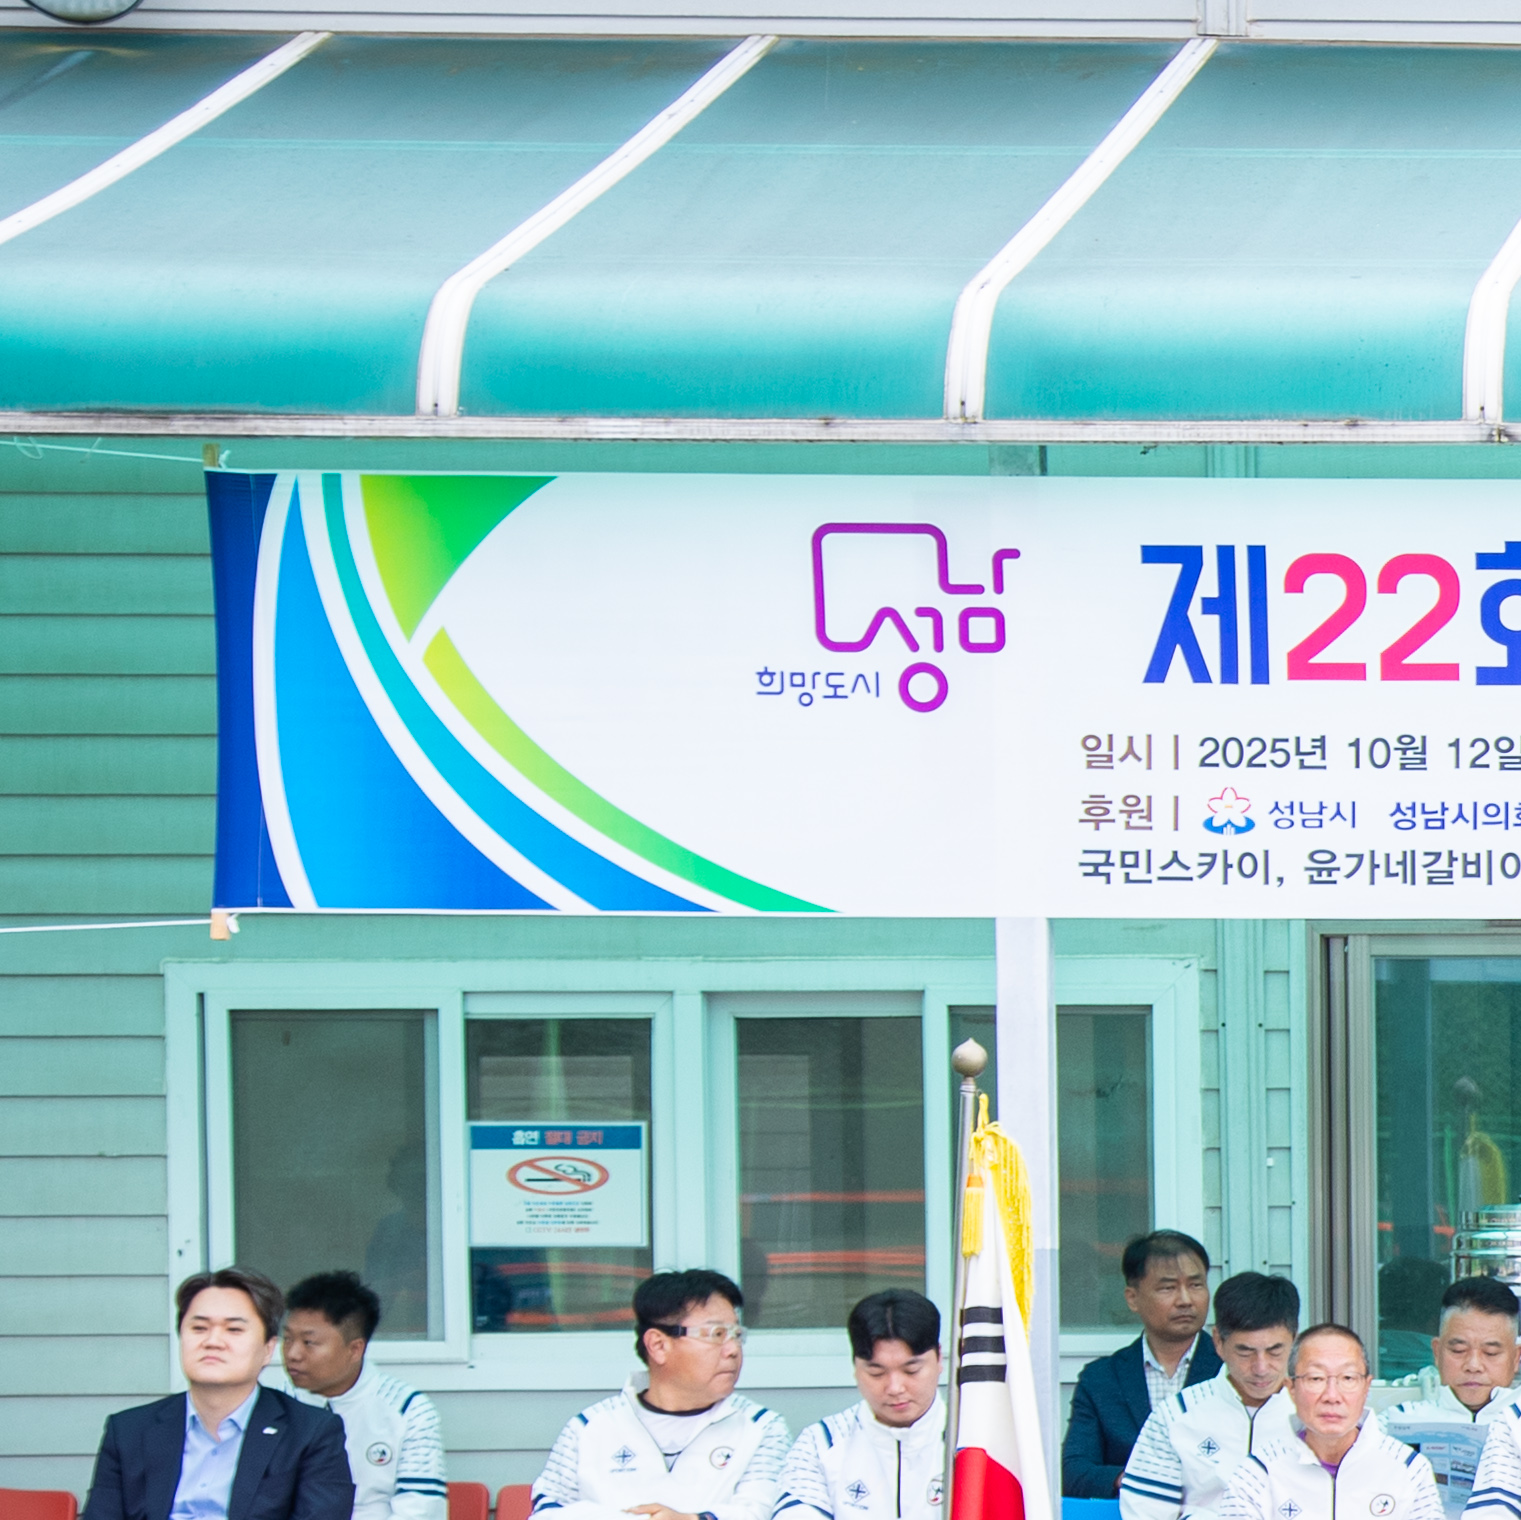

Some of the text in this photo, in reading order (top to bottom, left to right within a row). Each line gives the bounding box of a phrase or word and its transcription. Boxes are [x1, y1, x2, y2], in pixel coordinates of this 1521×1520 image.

[756, 667, 879, 707] 희망도시
[1081, 734, 1152, 770] 일시
[1199, 735, 1327, 770] 2025년
[1348, 734, 1427, 770] 10월
[1078, 794, 1153, 831] 후원
[1269, 801, 1355, 829] 성남시
[1079, 849, 1284, 887] 국민스카이,
